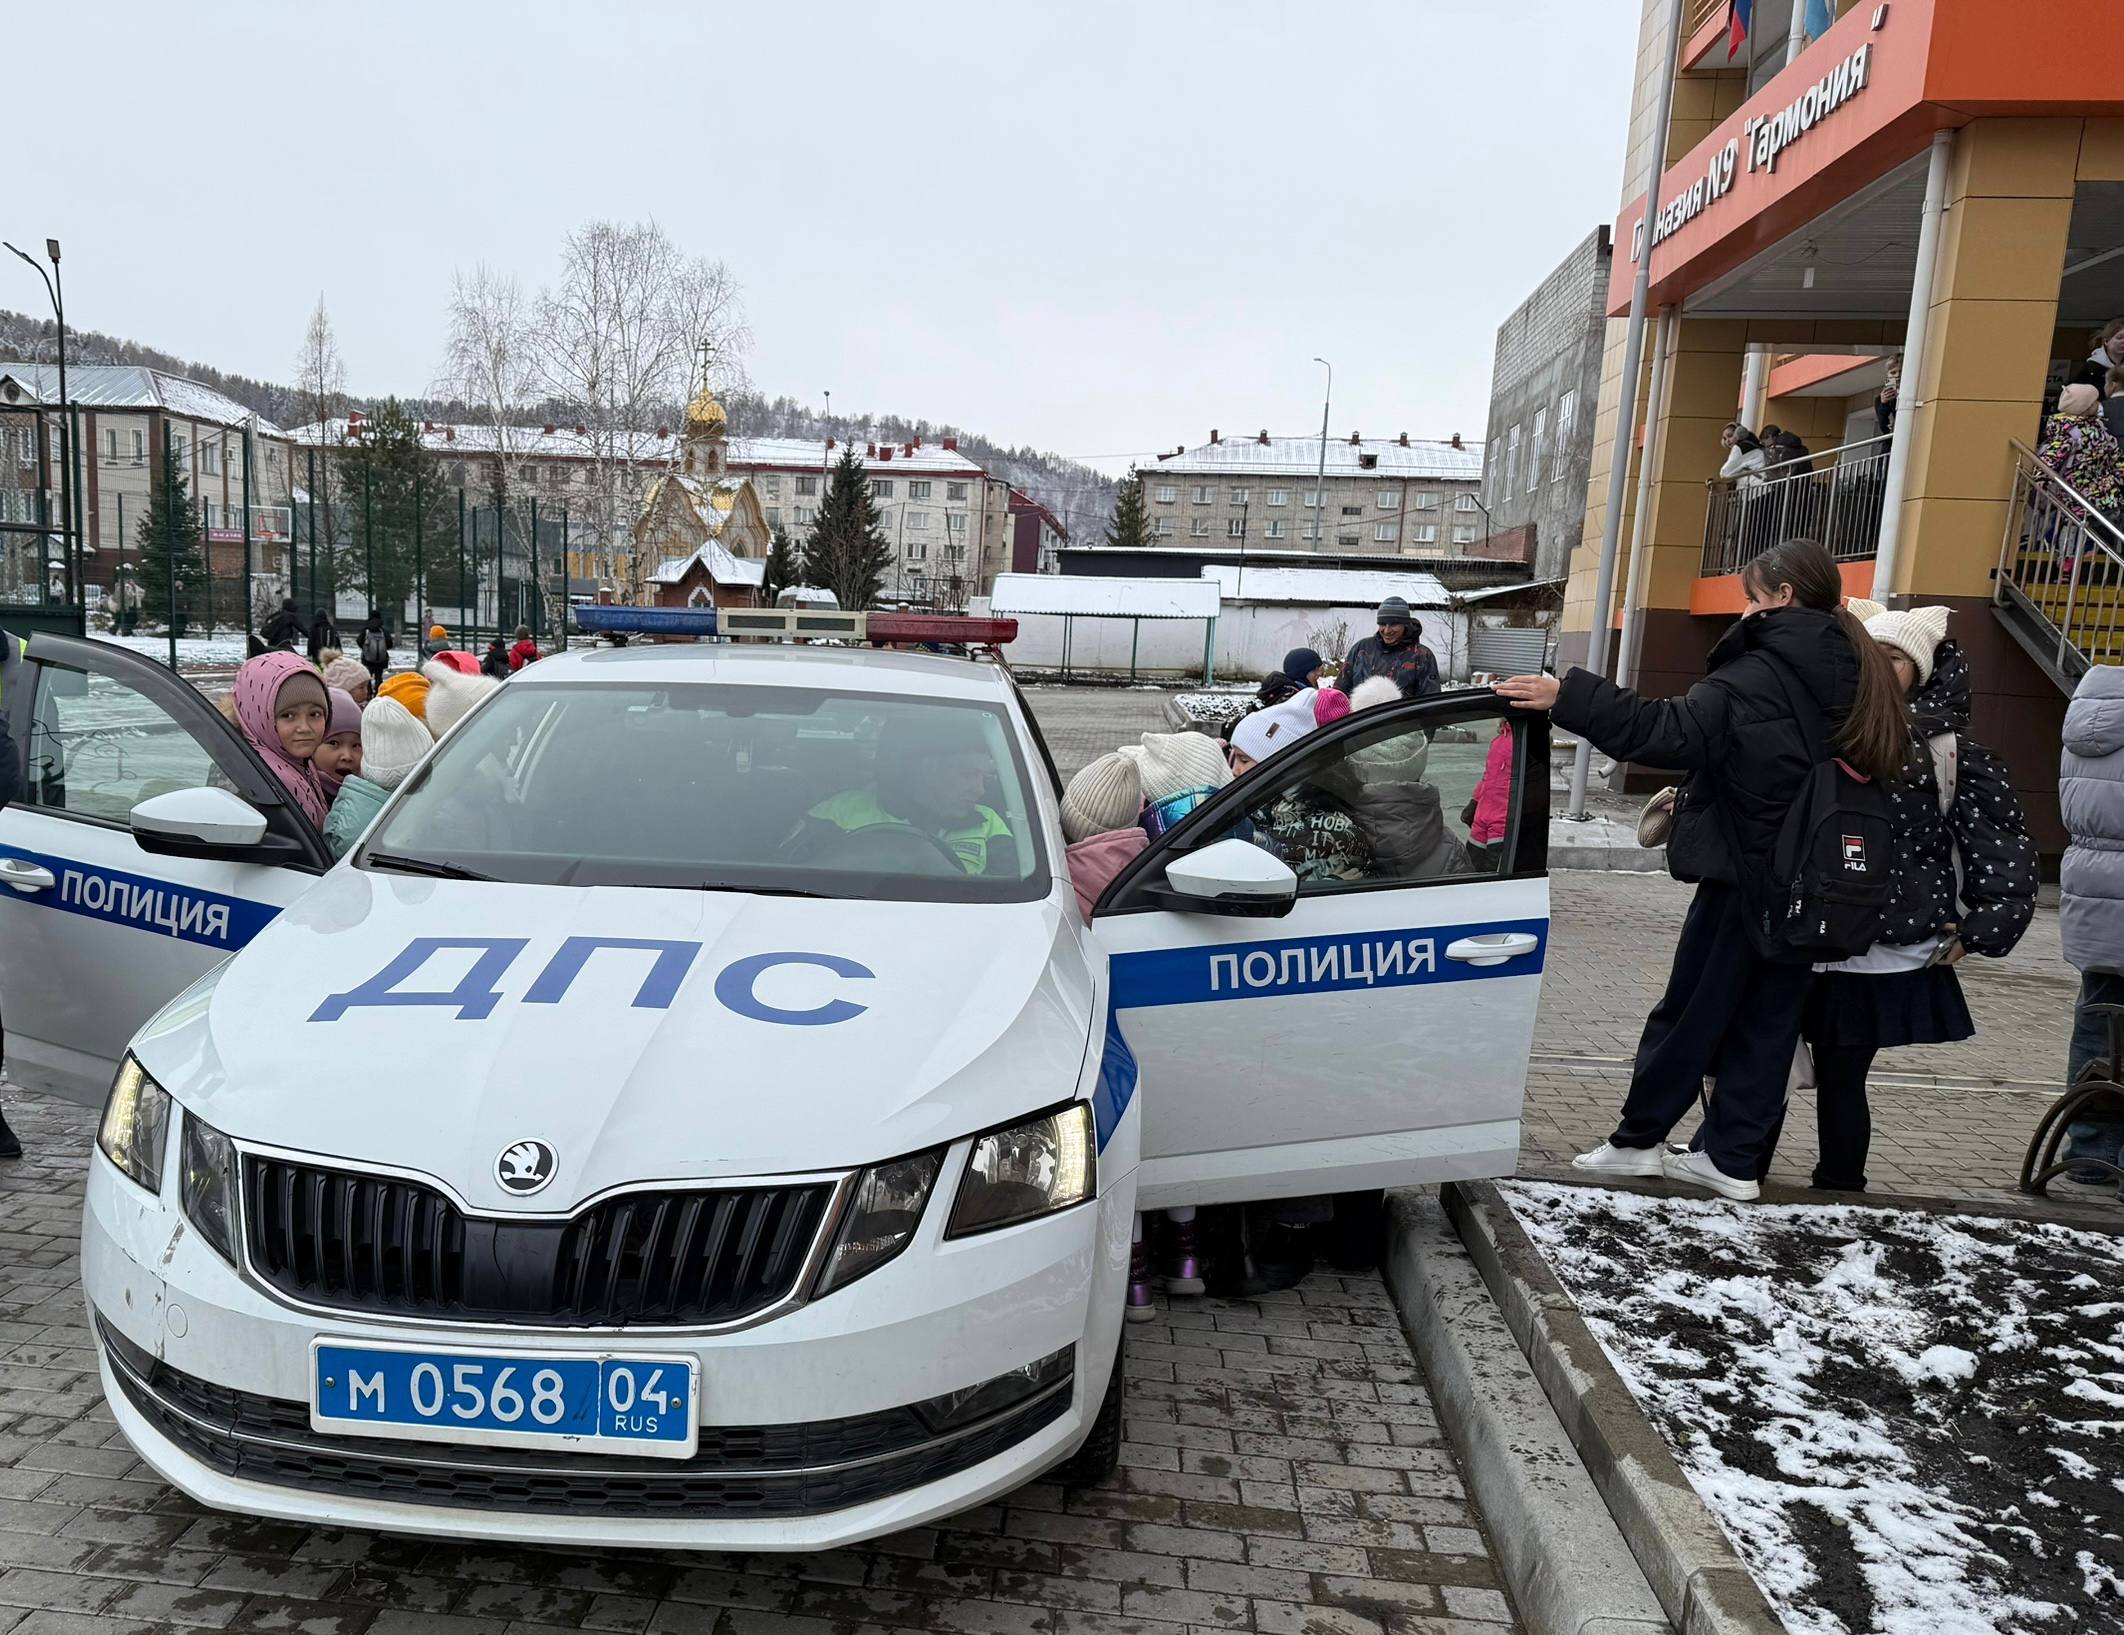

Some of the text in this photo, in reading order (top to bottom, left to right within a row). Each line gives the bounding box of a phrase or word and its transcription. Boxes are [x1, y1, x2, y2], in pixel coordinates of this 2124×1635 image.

[1630, 176, 1706, 263] Гназия
[1844, 860, 1867, 872] FILA
[61, 869, 230, 940] ПОЛИЦИЯ
[306, 936, 876, 1025] ДПС
[1209, 938, 1436, 991] ПОЛИЦИЯ
[348, 1362, 667, 1425] М 0568 04
[615, 1416, 658, 1434] RUS
